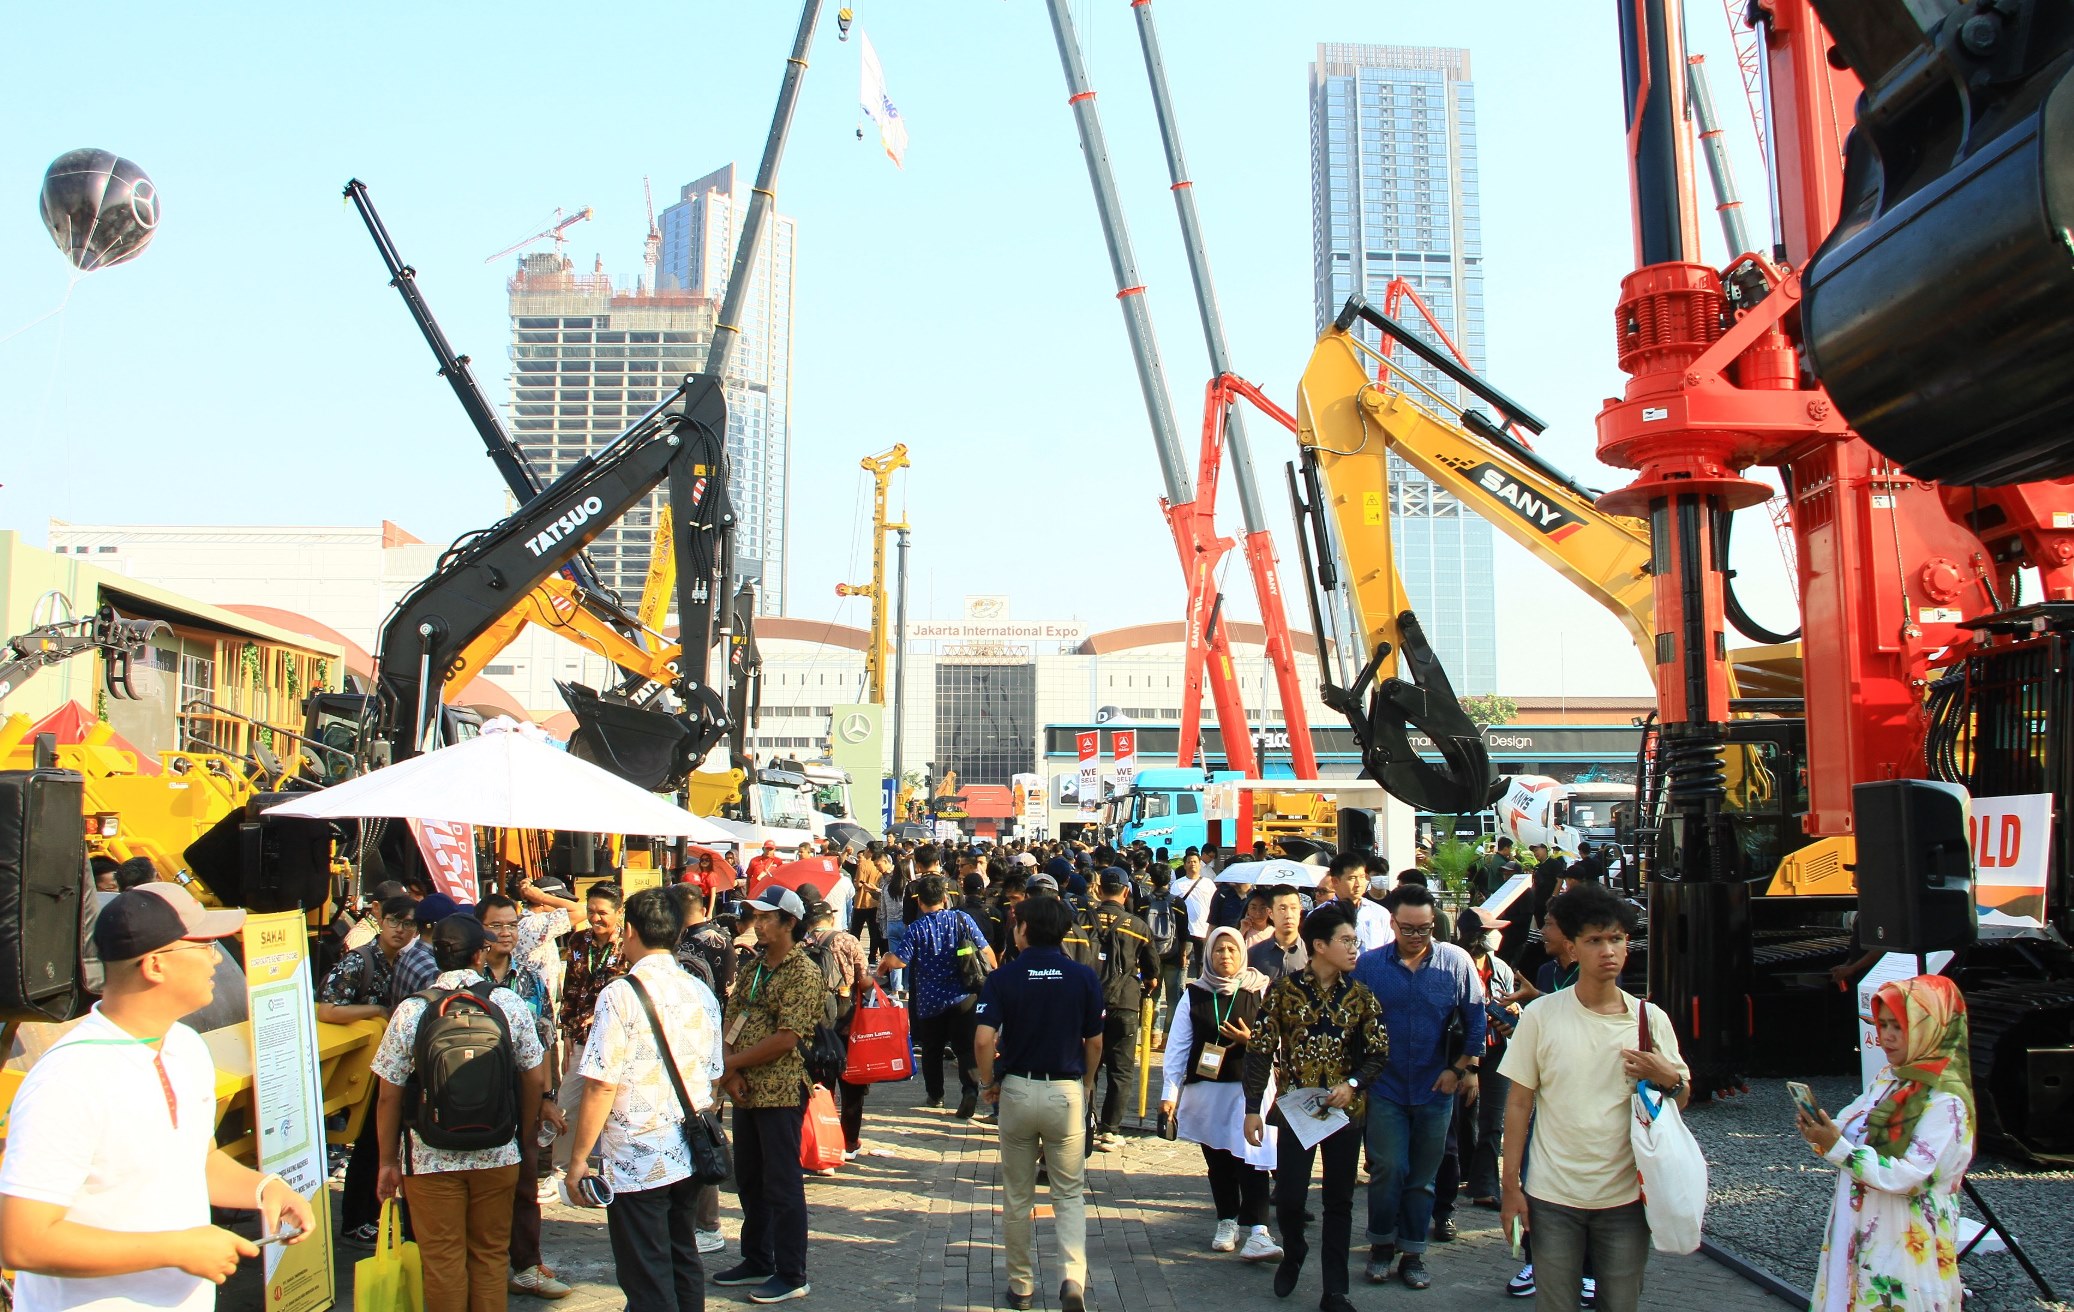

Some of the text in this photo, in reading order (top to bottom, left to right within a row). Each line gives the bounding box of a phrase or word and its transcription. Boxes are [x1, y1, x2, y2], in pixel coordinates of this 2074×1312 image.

[1480, 469, 1561, 526] SANY
[525, 496, 602, 557] TATSUO
[1266, 570, 1278, 595] SANY
[913, 625, 960, 636] Jakarta
[963, 625, 1041, 636] International
[1046, 626, 1079, 638] Expo
[1191, 621, 1201, 649] SANY
[1489, 735, 1533, 749] Design
[1080, 768, 1097, 776] WE
[1116, 767, 1132, 776] WE
[1511, 790, 1534, 811] SANY
[1135, 826, 1176, 838] SANY
[261, 929, 286, 944] SAKAI
